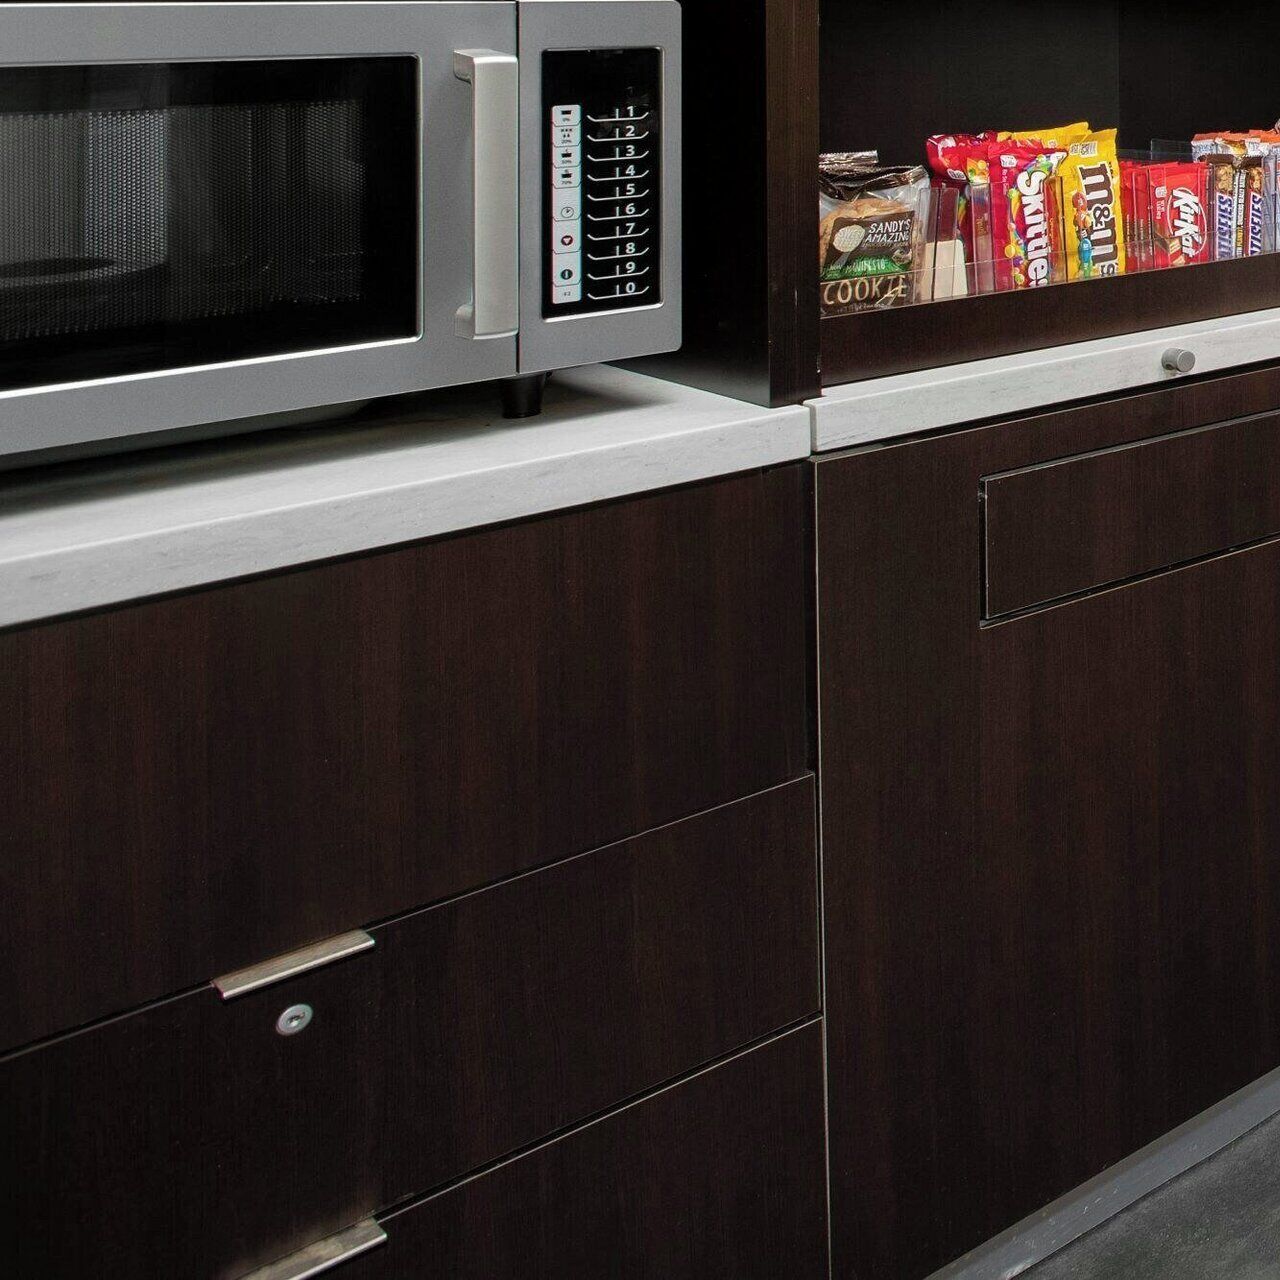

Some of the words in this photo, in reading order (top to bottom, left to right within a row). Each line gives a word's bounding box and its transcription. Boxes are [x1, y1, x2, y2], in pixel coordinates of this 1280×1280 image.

[626, 106, 635, 117] 1
[626, 126, 635, 137] 2
[626, 146, 635, 157] 3
[626, 165, 635, 176] 4
[626, 184, 635, 195] 5
[626, 203, 635, 215] 6
[626, 224, 635, 234] 7
[869, 218, 911, 234] SANDY'S
[626, 243, 635, 254] 8
[626, 262, 635, 273] 9
[626, 282, 635, 293] 0
[823, 274, 907, 305] COOKIE
